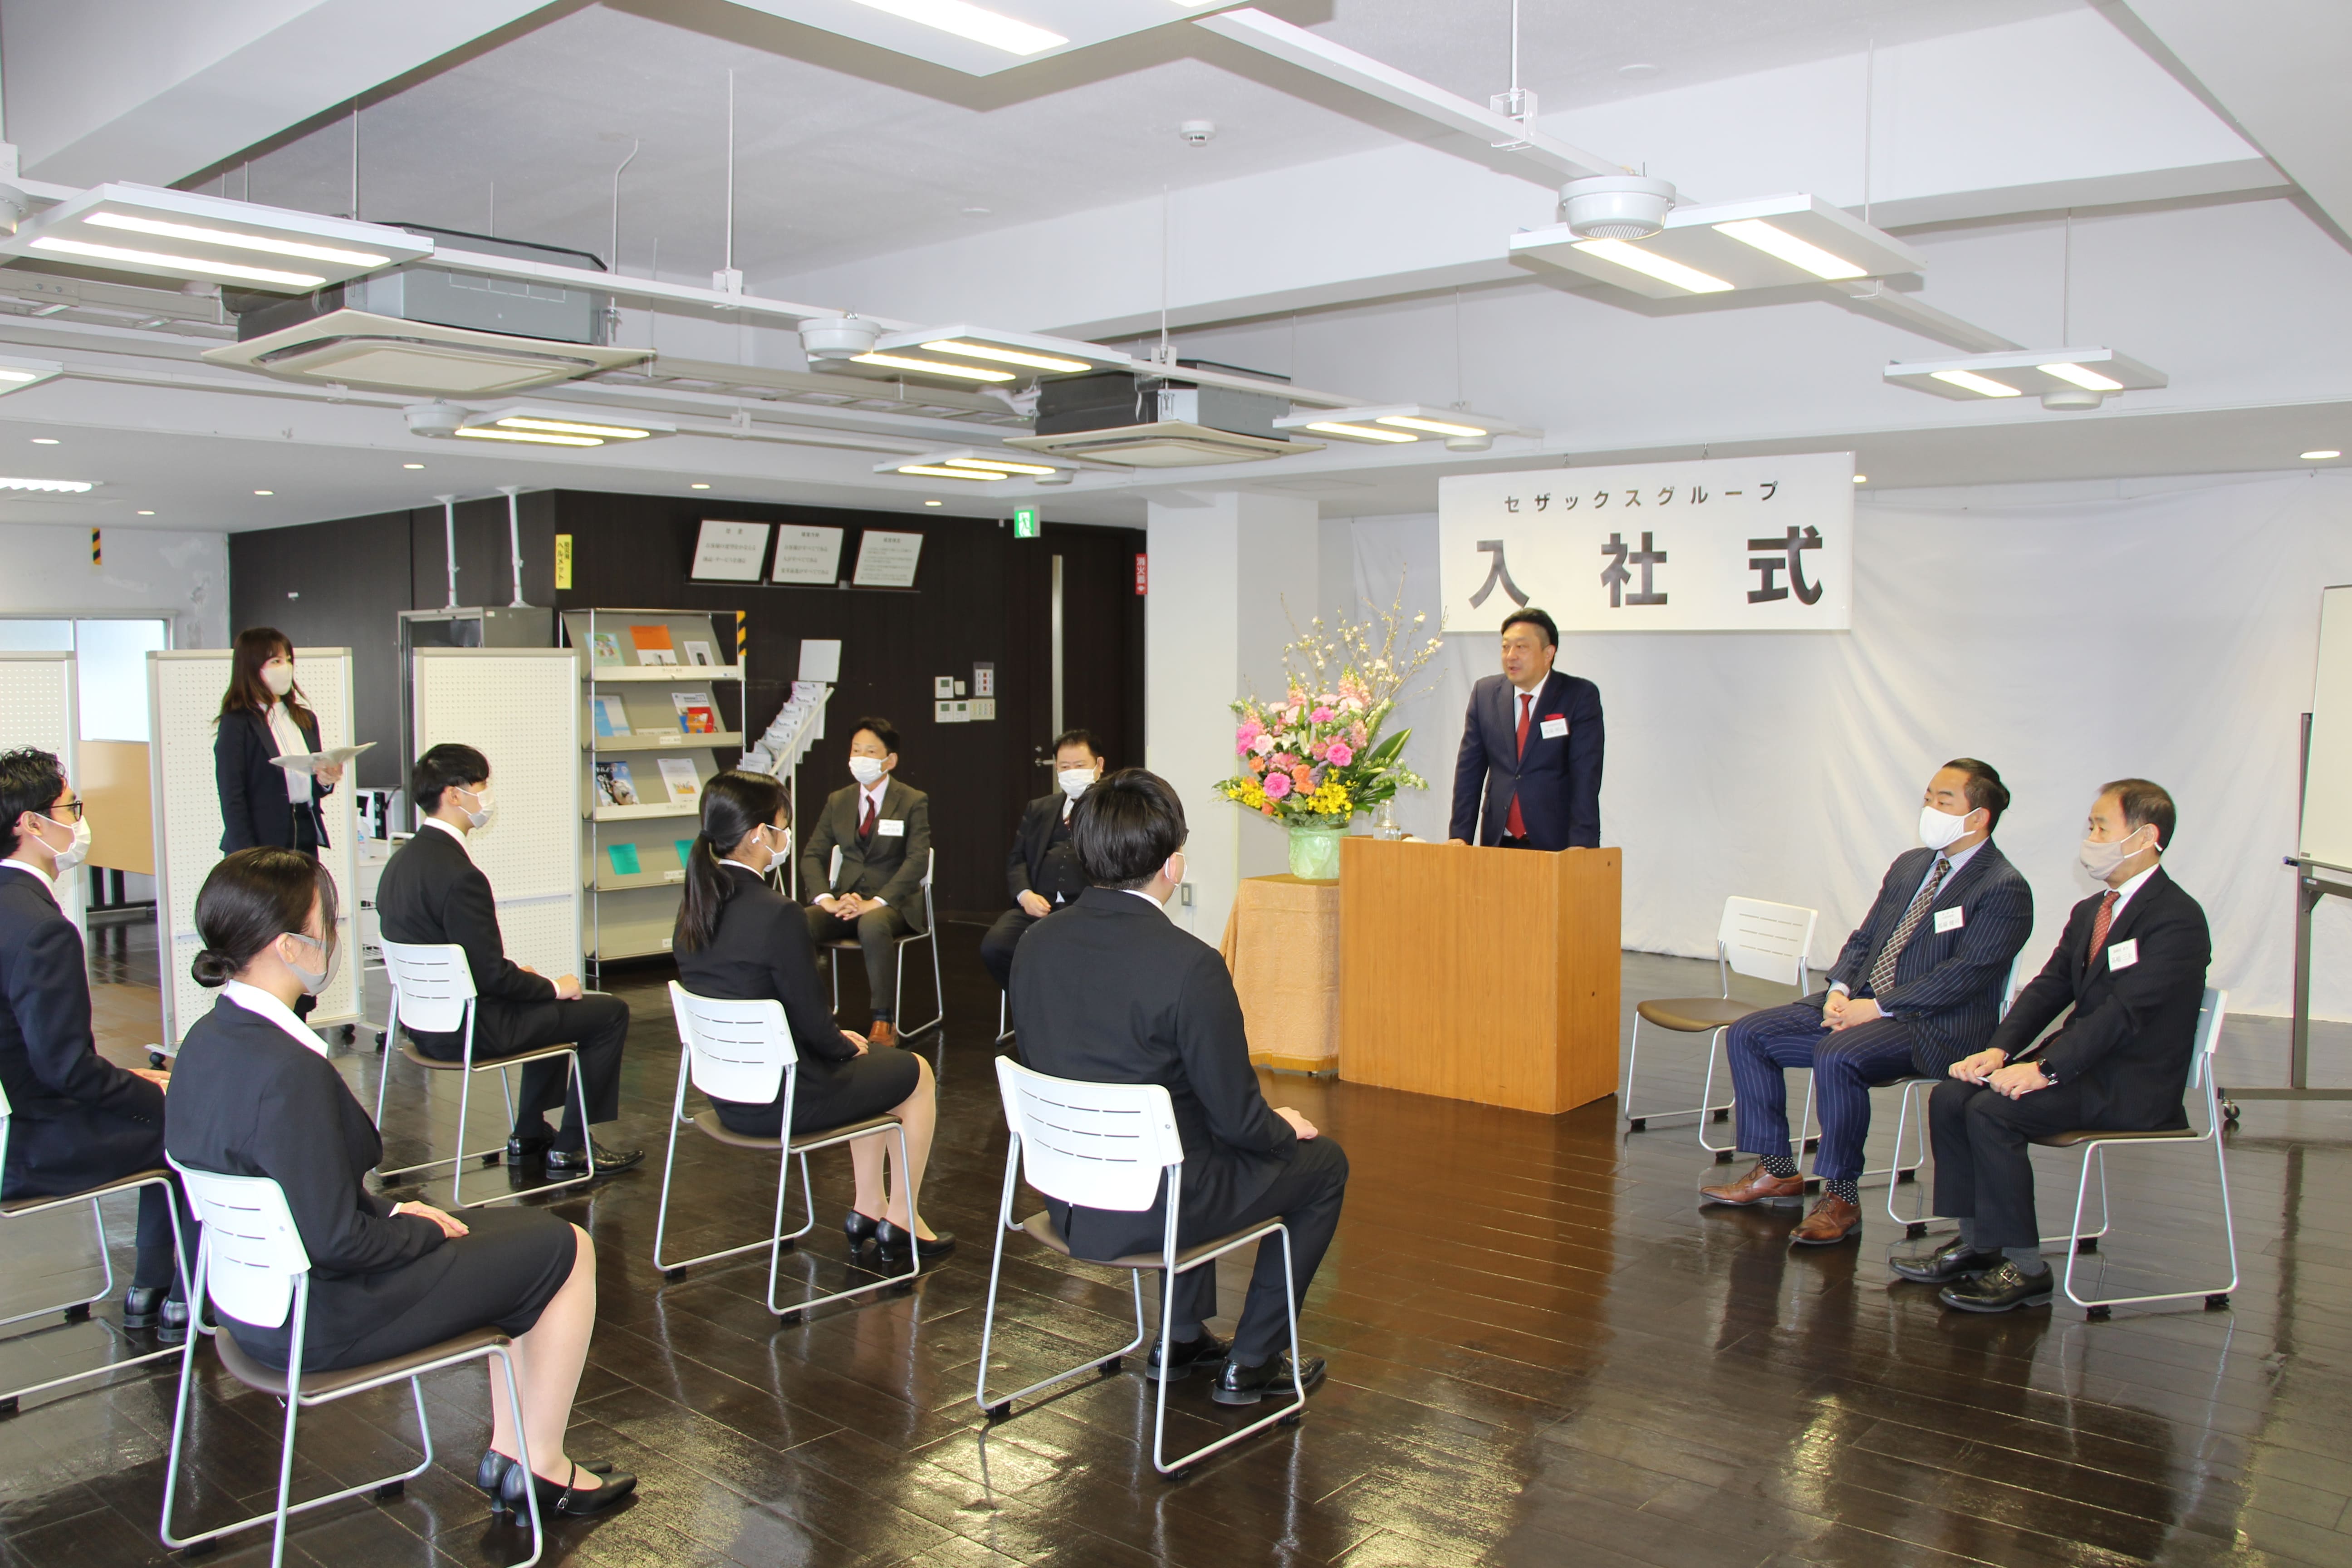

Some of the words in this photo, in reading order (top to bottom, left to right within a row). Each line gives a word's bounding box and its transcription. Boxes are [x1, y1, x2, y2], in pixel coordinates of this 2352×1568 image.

[1504, 480, 1778, 513] セザックスグループ
[1137, 557, 1146, 583] 消火器
[1469, 525, 1823, 608] 入社式
